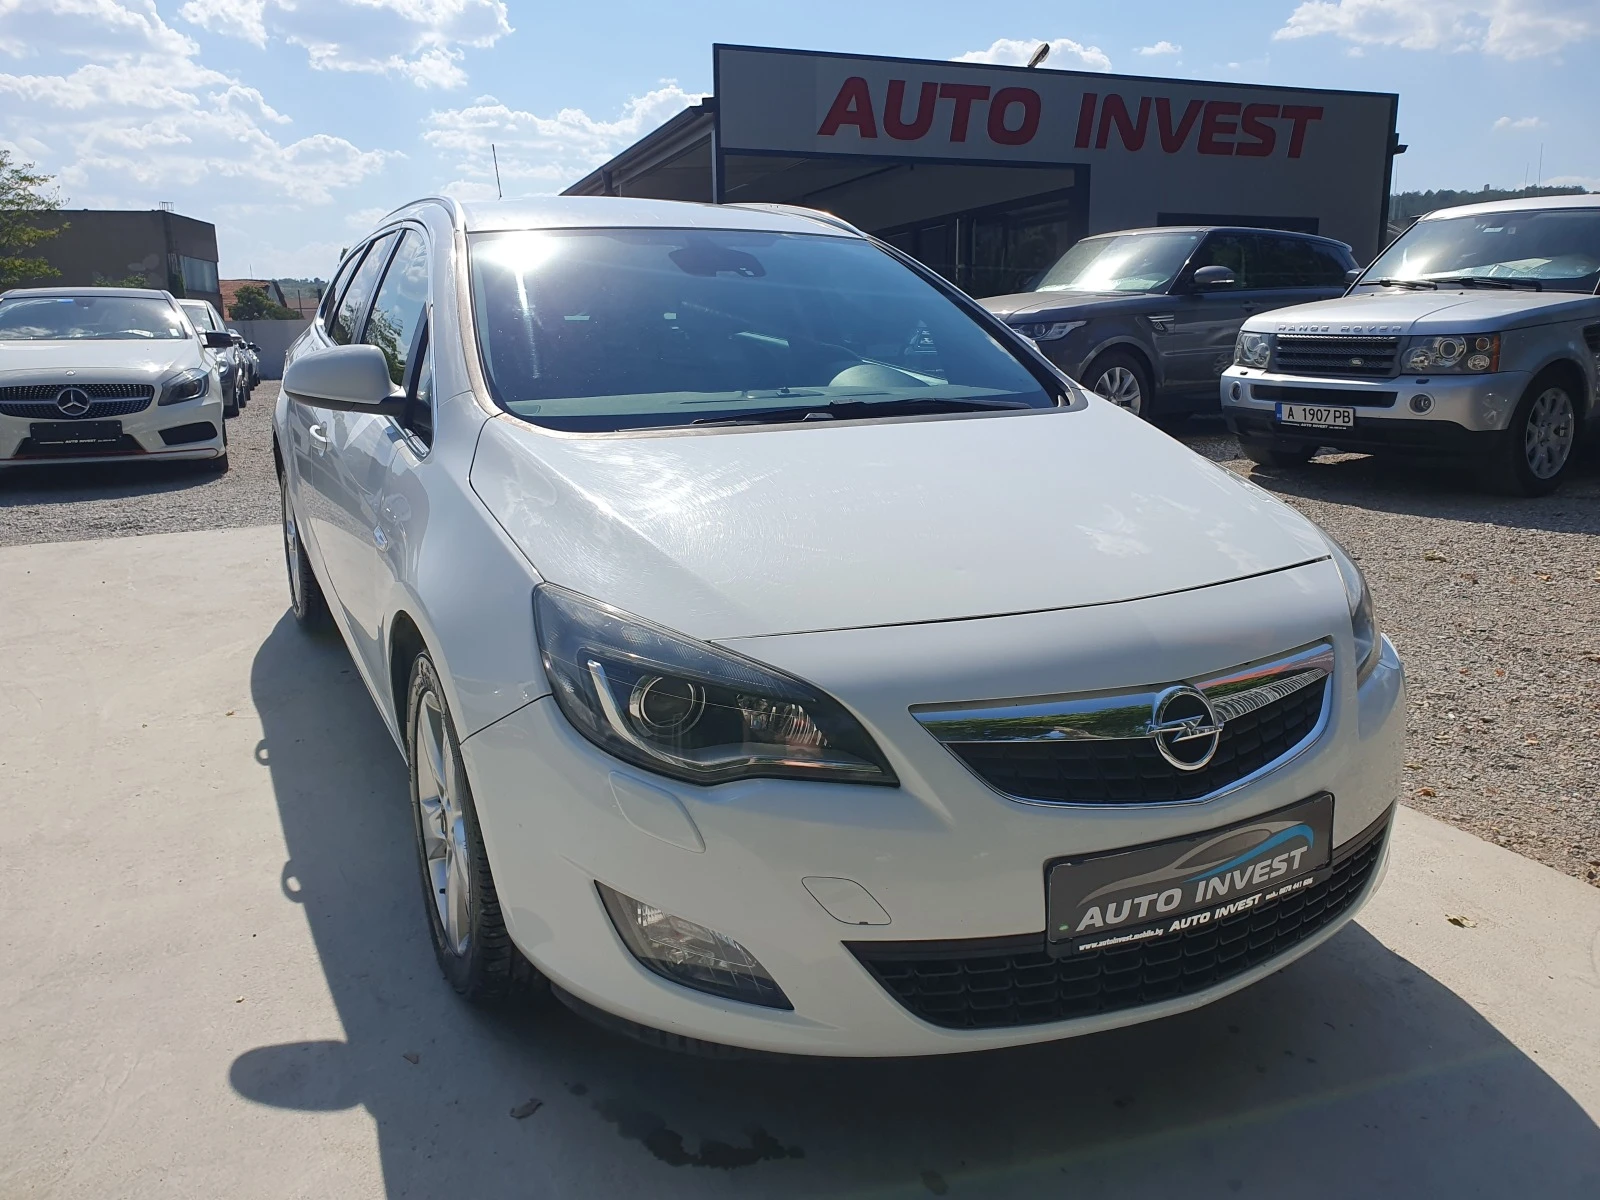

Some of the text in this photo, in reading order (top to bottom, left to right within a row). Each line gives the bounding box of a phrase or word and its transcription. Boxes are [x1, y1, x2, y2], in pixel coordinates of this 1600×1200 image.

[817, 76, 1324, 159] AUTO INVEST
[1278, 324, 1402, 333] RANGE ROVER
[1287, 406, 1351, 424] A 1907 PB
[1075, 845, 1309, 932] AUTO INVEST
[1168, 912, 1211, 932] AUTO
[1214, 893, 1263, 920] INVEST
